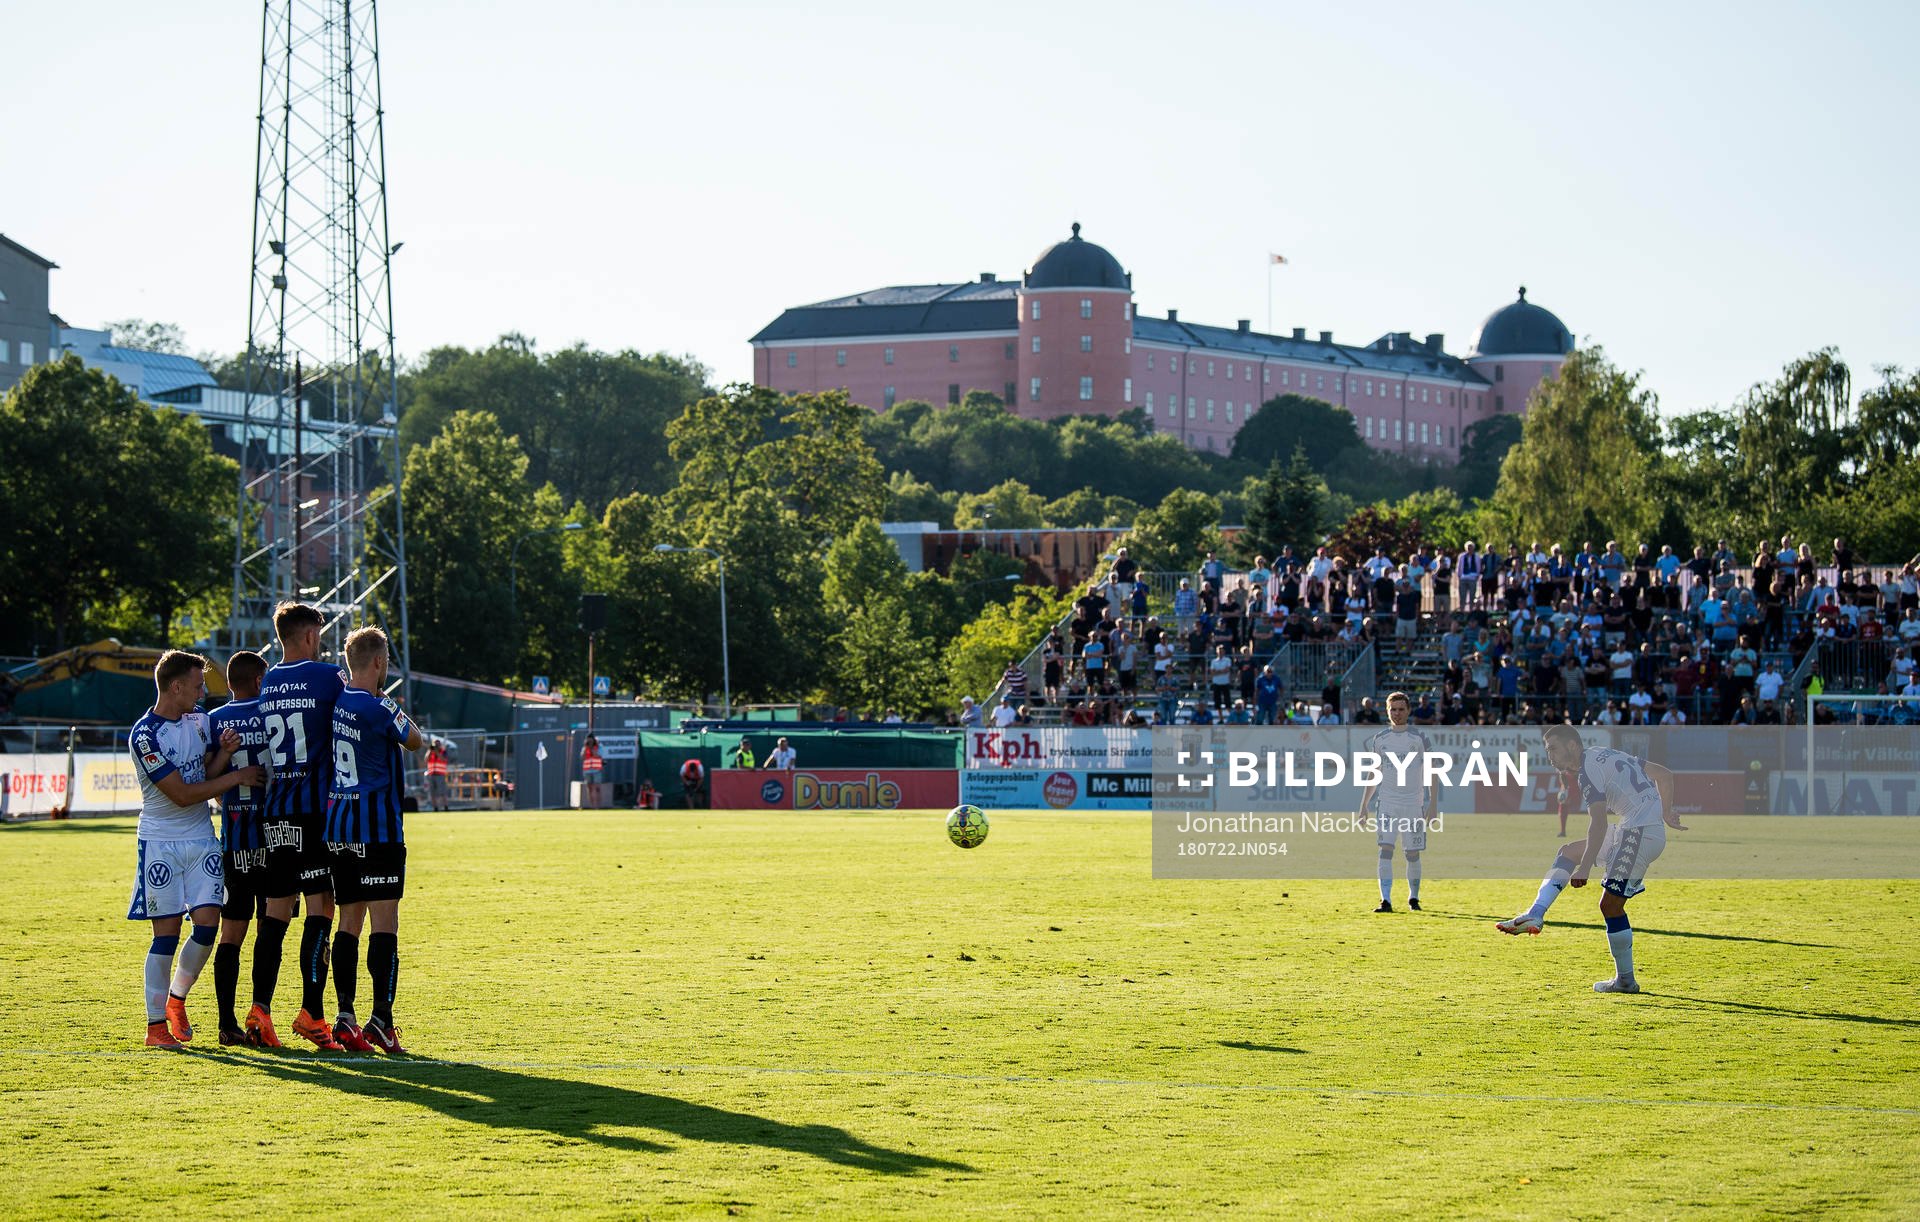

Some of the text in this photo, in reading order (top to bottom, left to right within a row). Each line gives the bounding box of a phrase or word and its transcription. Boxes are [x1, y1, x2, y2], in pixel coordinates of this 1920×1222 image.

[290, 682, 308, 691] TAK
[276, 698, 316, 710] PERSSON
[216, 716, 248, 730] ÅRSTA
[265, 712, 308, 767] 21
[1110, 745, 1139, 757] Sirius
[4, 769, 67, 798] LÖJTE AB
[1092, 778, 1118, 792] Mc
[1125, 777, 1173, 793] Miller
[794, 772, 902, 809] Dumle
[1412, 836, 1422, 845] 20
[387, 875, 399, 884] AB
